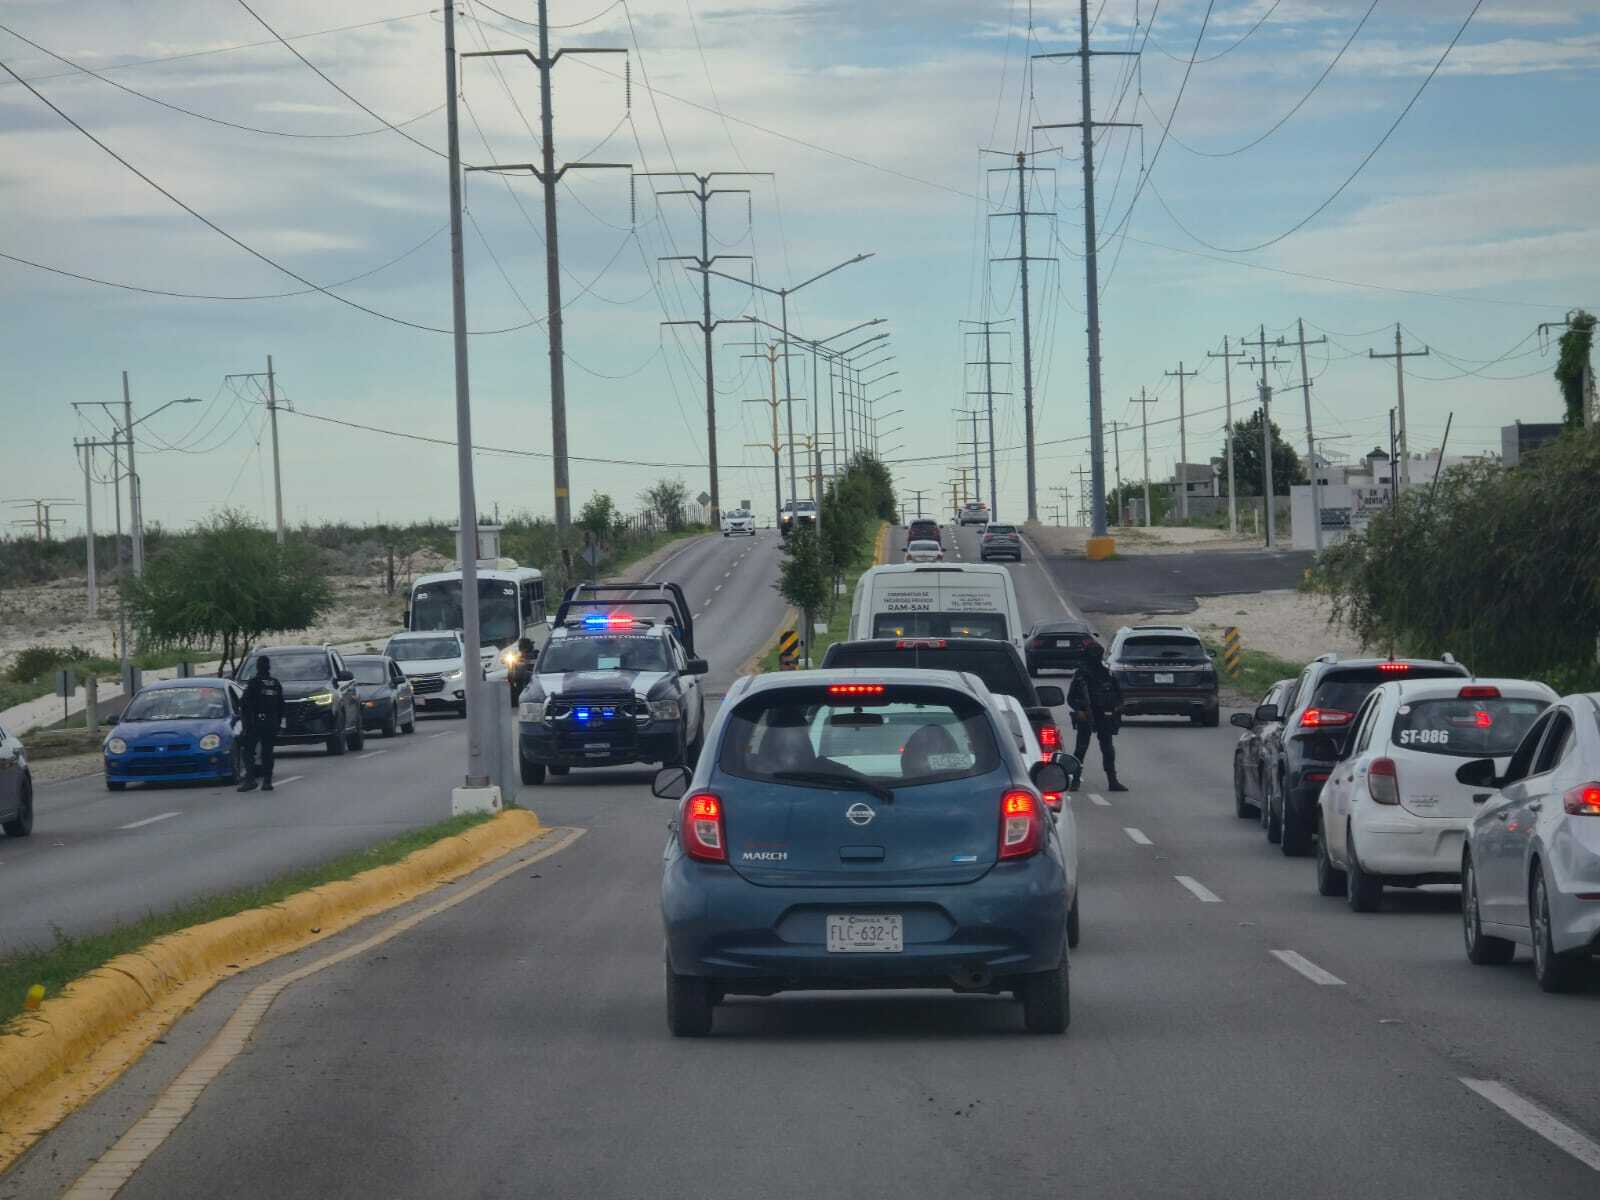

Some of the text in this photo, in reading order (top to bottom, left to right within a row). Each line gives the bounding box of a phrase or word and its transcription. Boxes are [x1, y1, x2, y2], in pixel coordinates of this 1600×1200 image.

[1400, 729, 1449, 744] ST-086
[742, 852, 788, 860] MARCH
[831, 925, 898, 940] FLC-632-C
